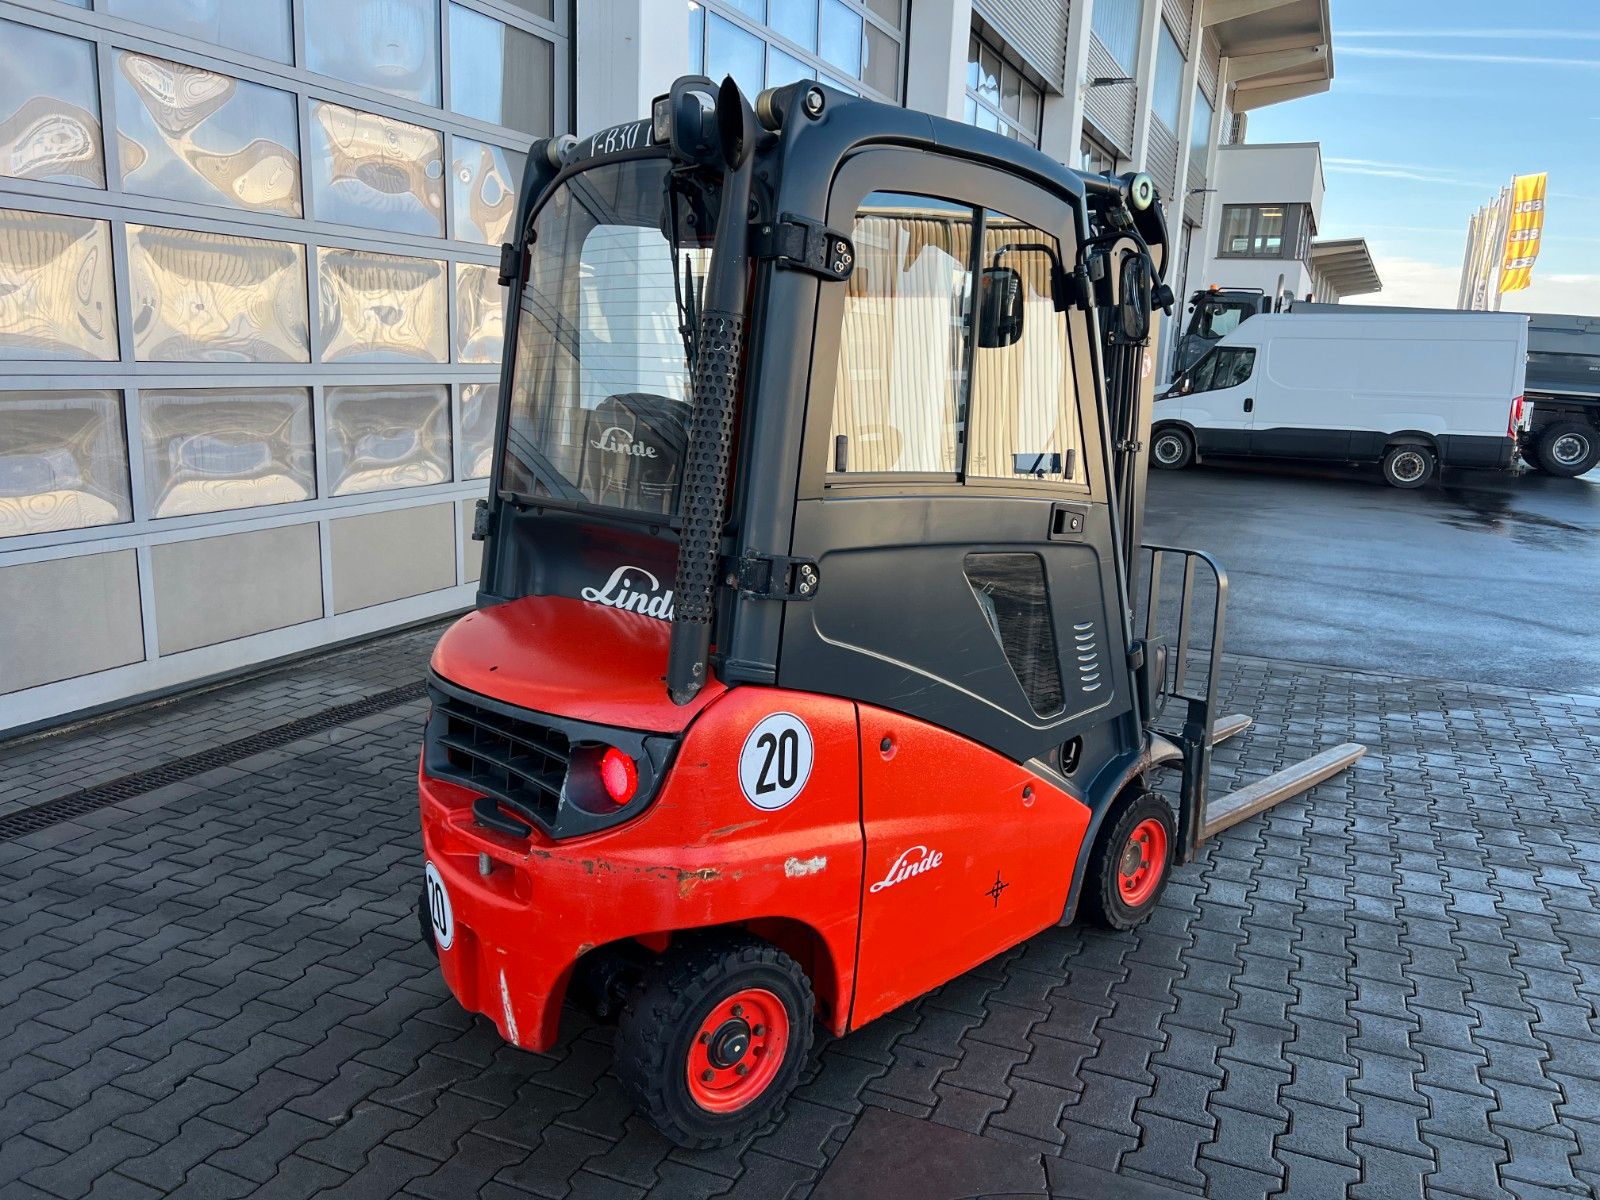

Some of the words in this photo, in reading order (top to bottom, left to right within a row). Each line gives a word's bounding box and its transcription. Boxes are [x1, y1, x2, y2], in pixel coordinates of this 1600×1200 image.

[1514, 200, 1544, 213] JCB
[1510, 229, 1539, 242] JCB
[590, 427, 658, 458] Linde
[581, 565, 675, 622] Lind
[755, 728, 799, 794] 20
[869, 845, 943, 893] Linde
[428, 874, 447, 936] 20
